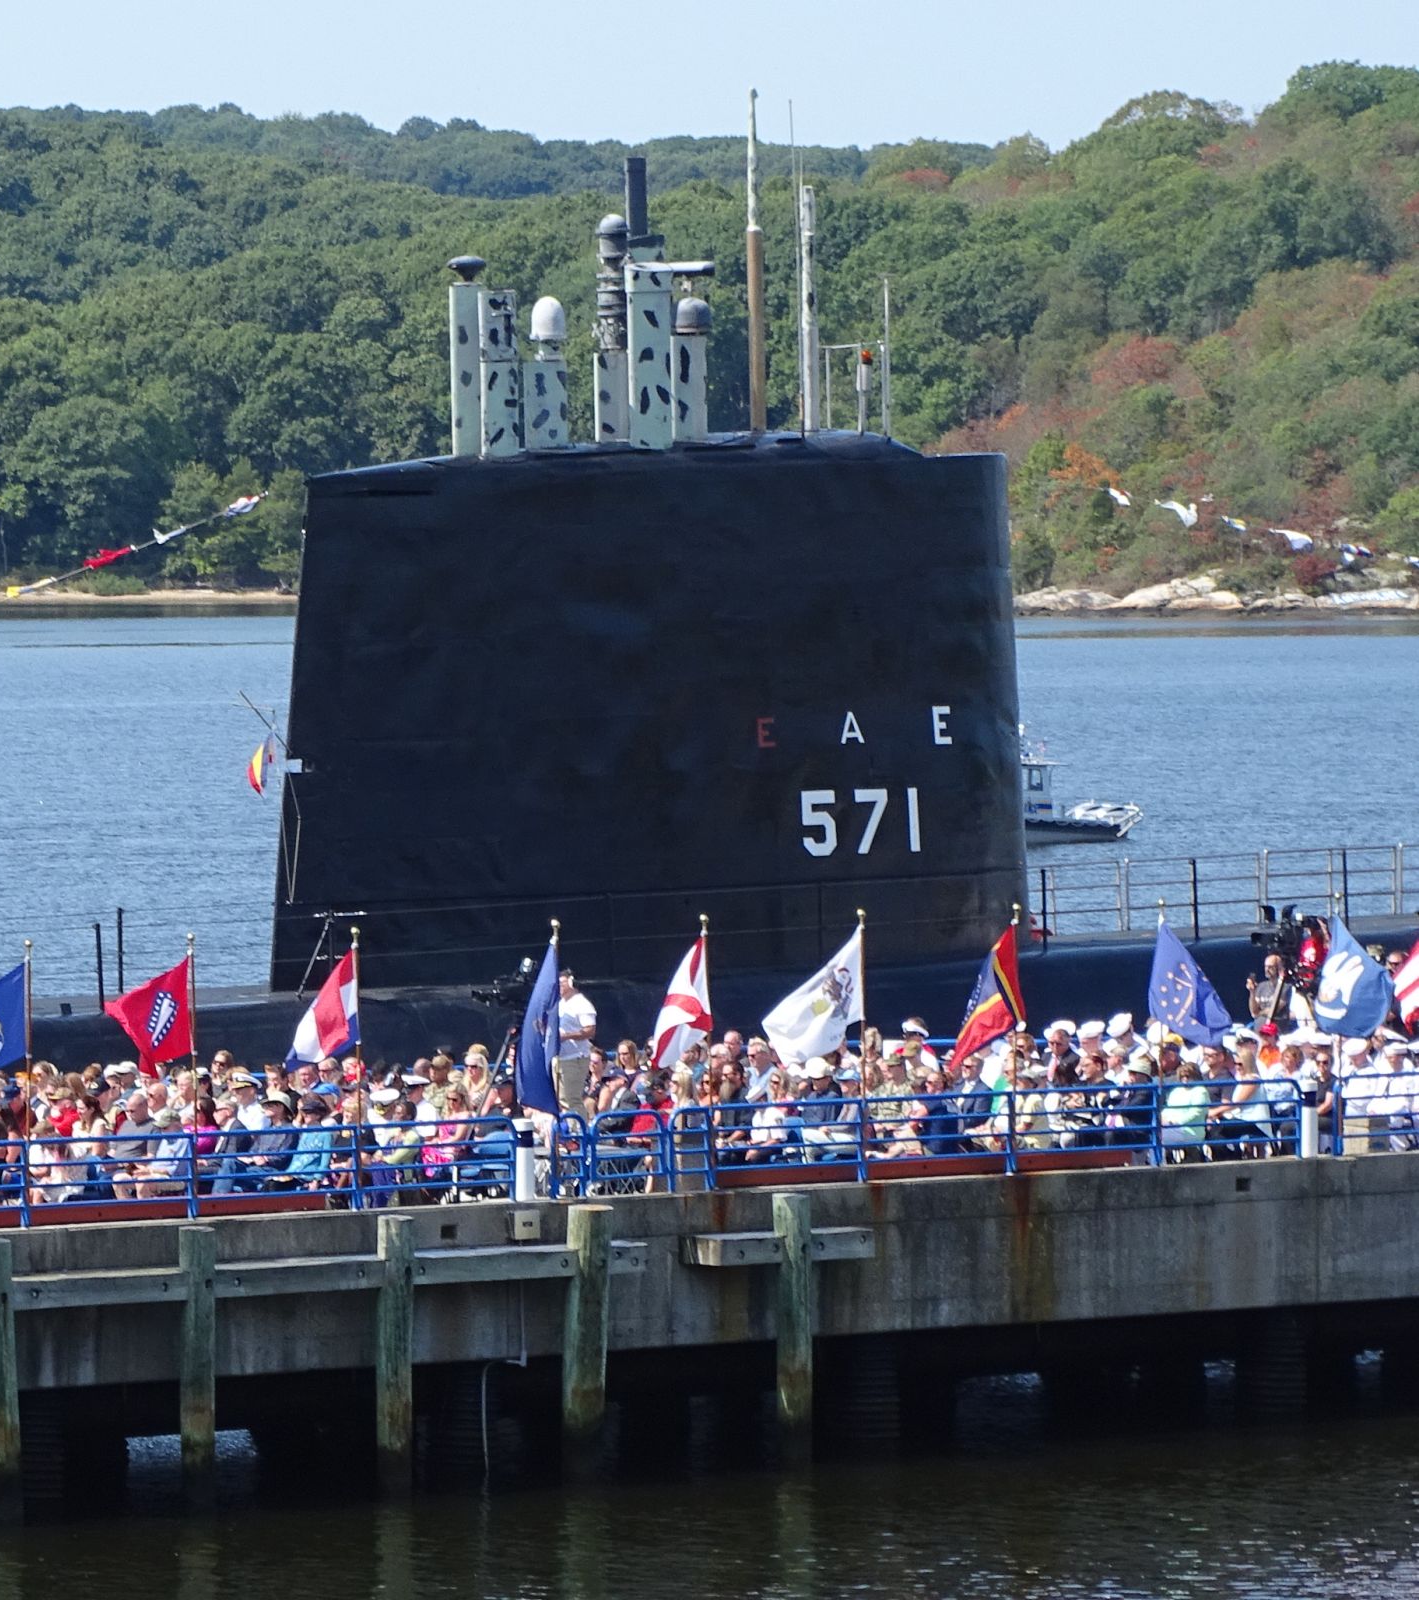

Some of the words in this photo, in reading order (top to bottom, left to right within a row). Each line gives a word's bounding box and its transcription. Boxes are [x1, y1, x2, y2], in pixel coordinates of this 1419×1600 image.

[756, 717, 776, 748] E
[841, 711, 865, 744] A
[932, 706, 953, 745] E
[801, 787, 921, 857] 571
